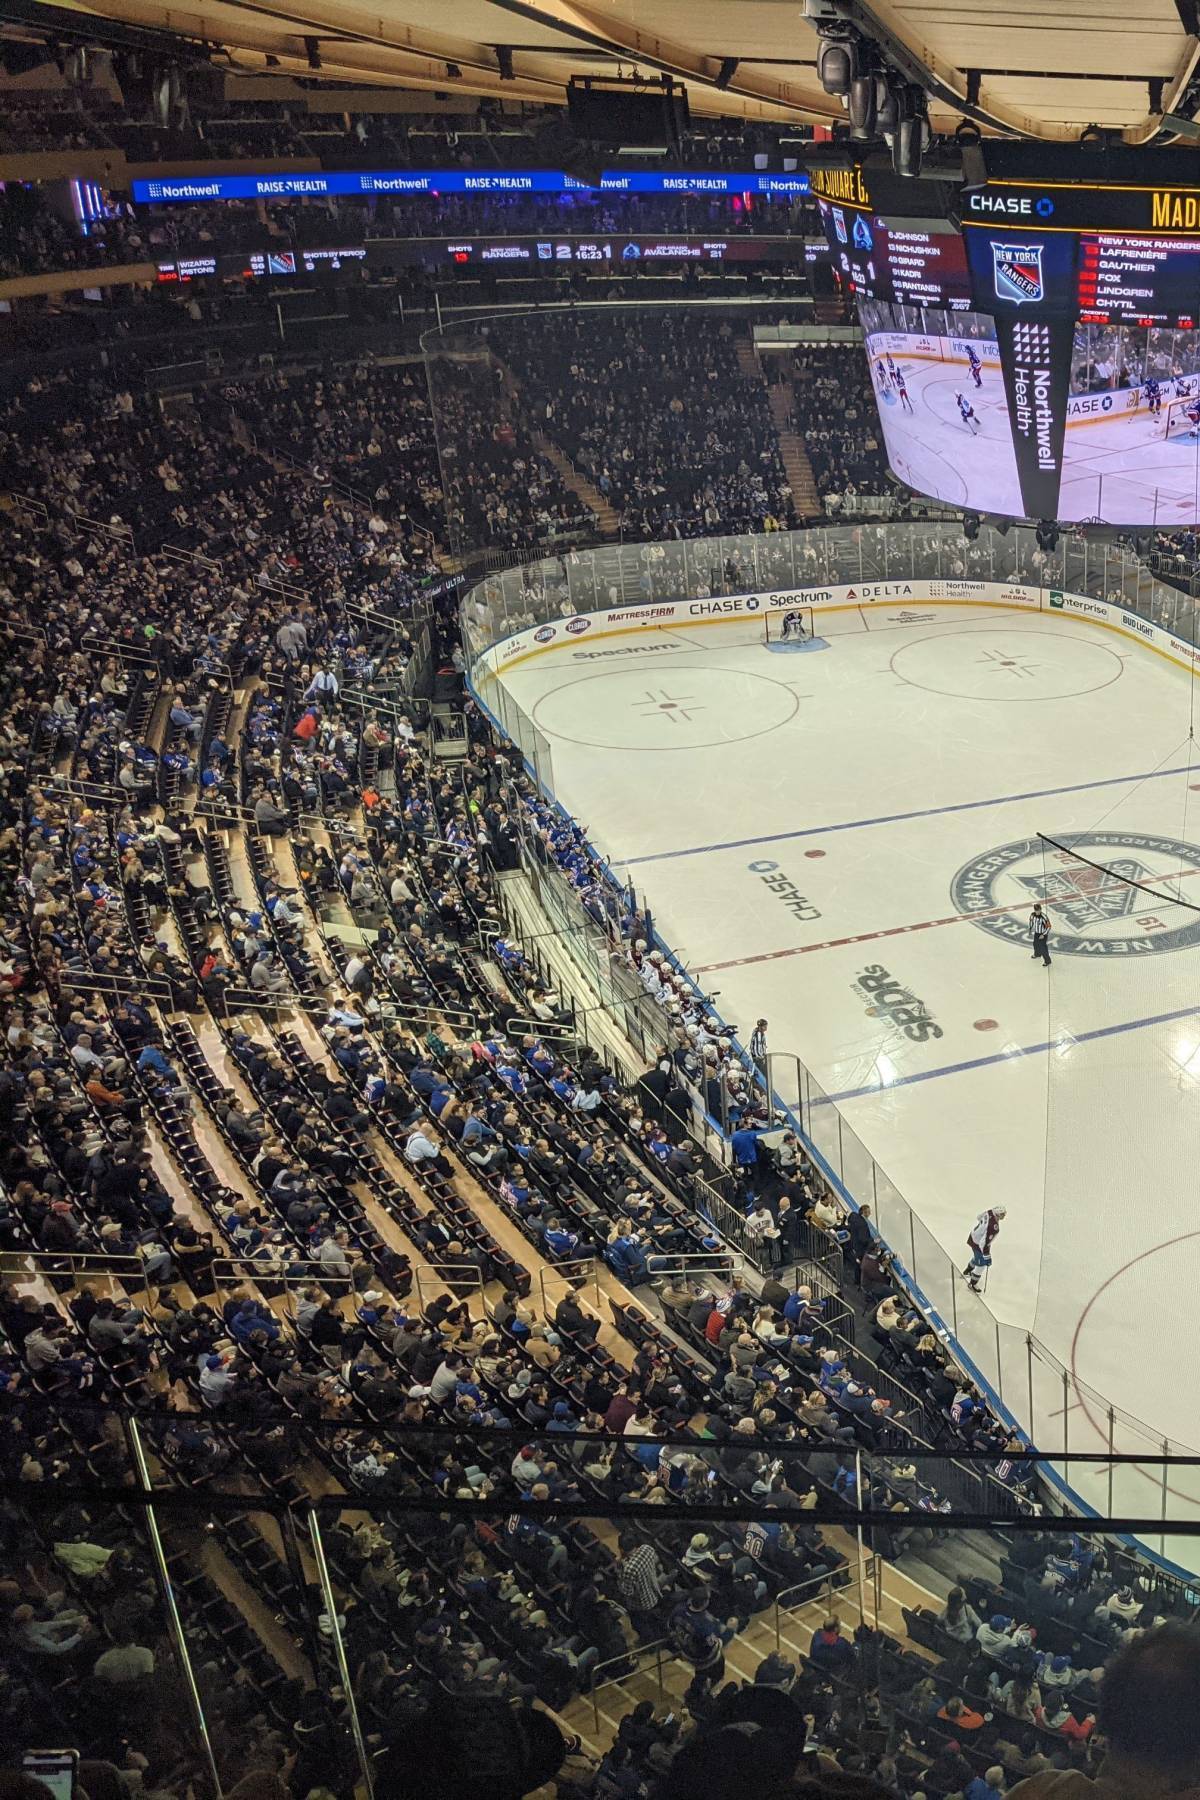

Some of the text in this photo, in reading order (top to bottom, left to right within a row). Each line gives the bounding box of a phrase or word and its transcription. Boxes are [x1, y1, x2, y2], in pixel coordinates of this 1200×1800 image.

[257, 180, 328, 192] RAISE HEALTH
[374, 177, 428, 190] Northwell
[465, 178, 531, 188] RAISE HEALTH
[663, 178, 727, 189] RAISE HEALTH
[163, 184, 219, 197] Northwell
[970, 195, 1032, 214] CHASE
[894, 232, 929, 242] JOHNSON
[1098, 236, 1124, 245] NEW
[1125, 239, 1153, 247] YORK
[556, 245, 572, 259] 2
[575, 251, 602, 259] 16:23
[644, 248, 701, 256] AVALANCHE
[995, 249, 1038, 263] NEW YORK
[180, 259, 216, 269] WIZARDS
[1099, 260, 1155, 272] GAUTHIER
[181, 267, 215, 276] PISTONS
[1098, 273, 1122, 283] FOX
[1001, 263, 1039, 297] RANGERS
[1097, 286, 1153, 298] LINDGREN
[1096, 299, 1136, 309] CHYTIL
[1014, 367, 1033, 431] Health
[1066, 399, 1099, 416] HASE
[1033, 369, 1056, 470] Northwell
[862, 585, 912, 597] DELTA
[946, 581, 986, 591] Northwell
[769, 591, 829, 607] Spectrum
[1052, 595, 1108, 616] enterprise
[689, 600, 743, 615] CHASE
[1122, 615, 1154, 638] BUD LIGHT
[572, 642, 677, 661] Spectrum
[1094, 836, 1173, 851] GARDEN
[962, 849, 1021, 910] RANGERS
[760, 873, 822, 921] CHASE
[1136, 916, 1168, 932] 19
